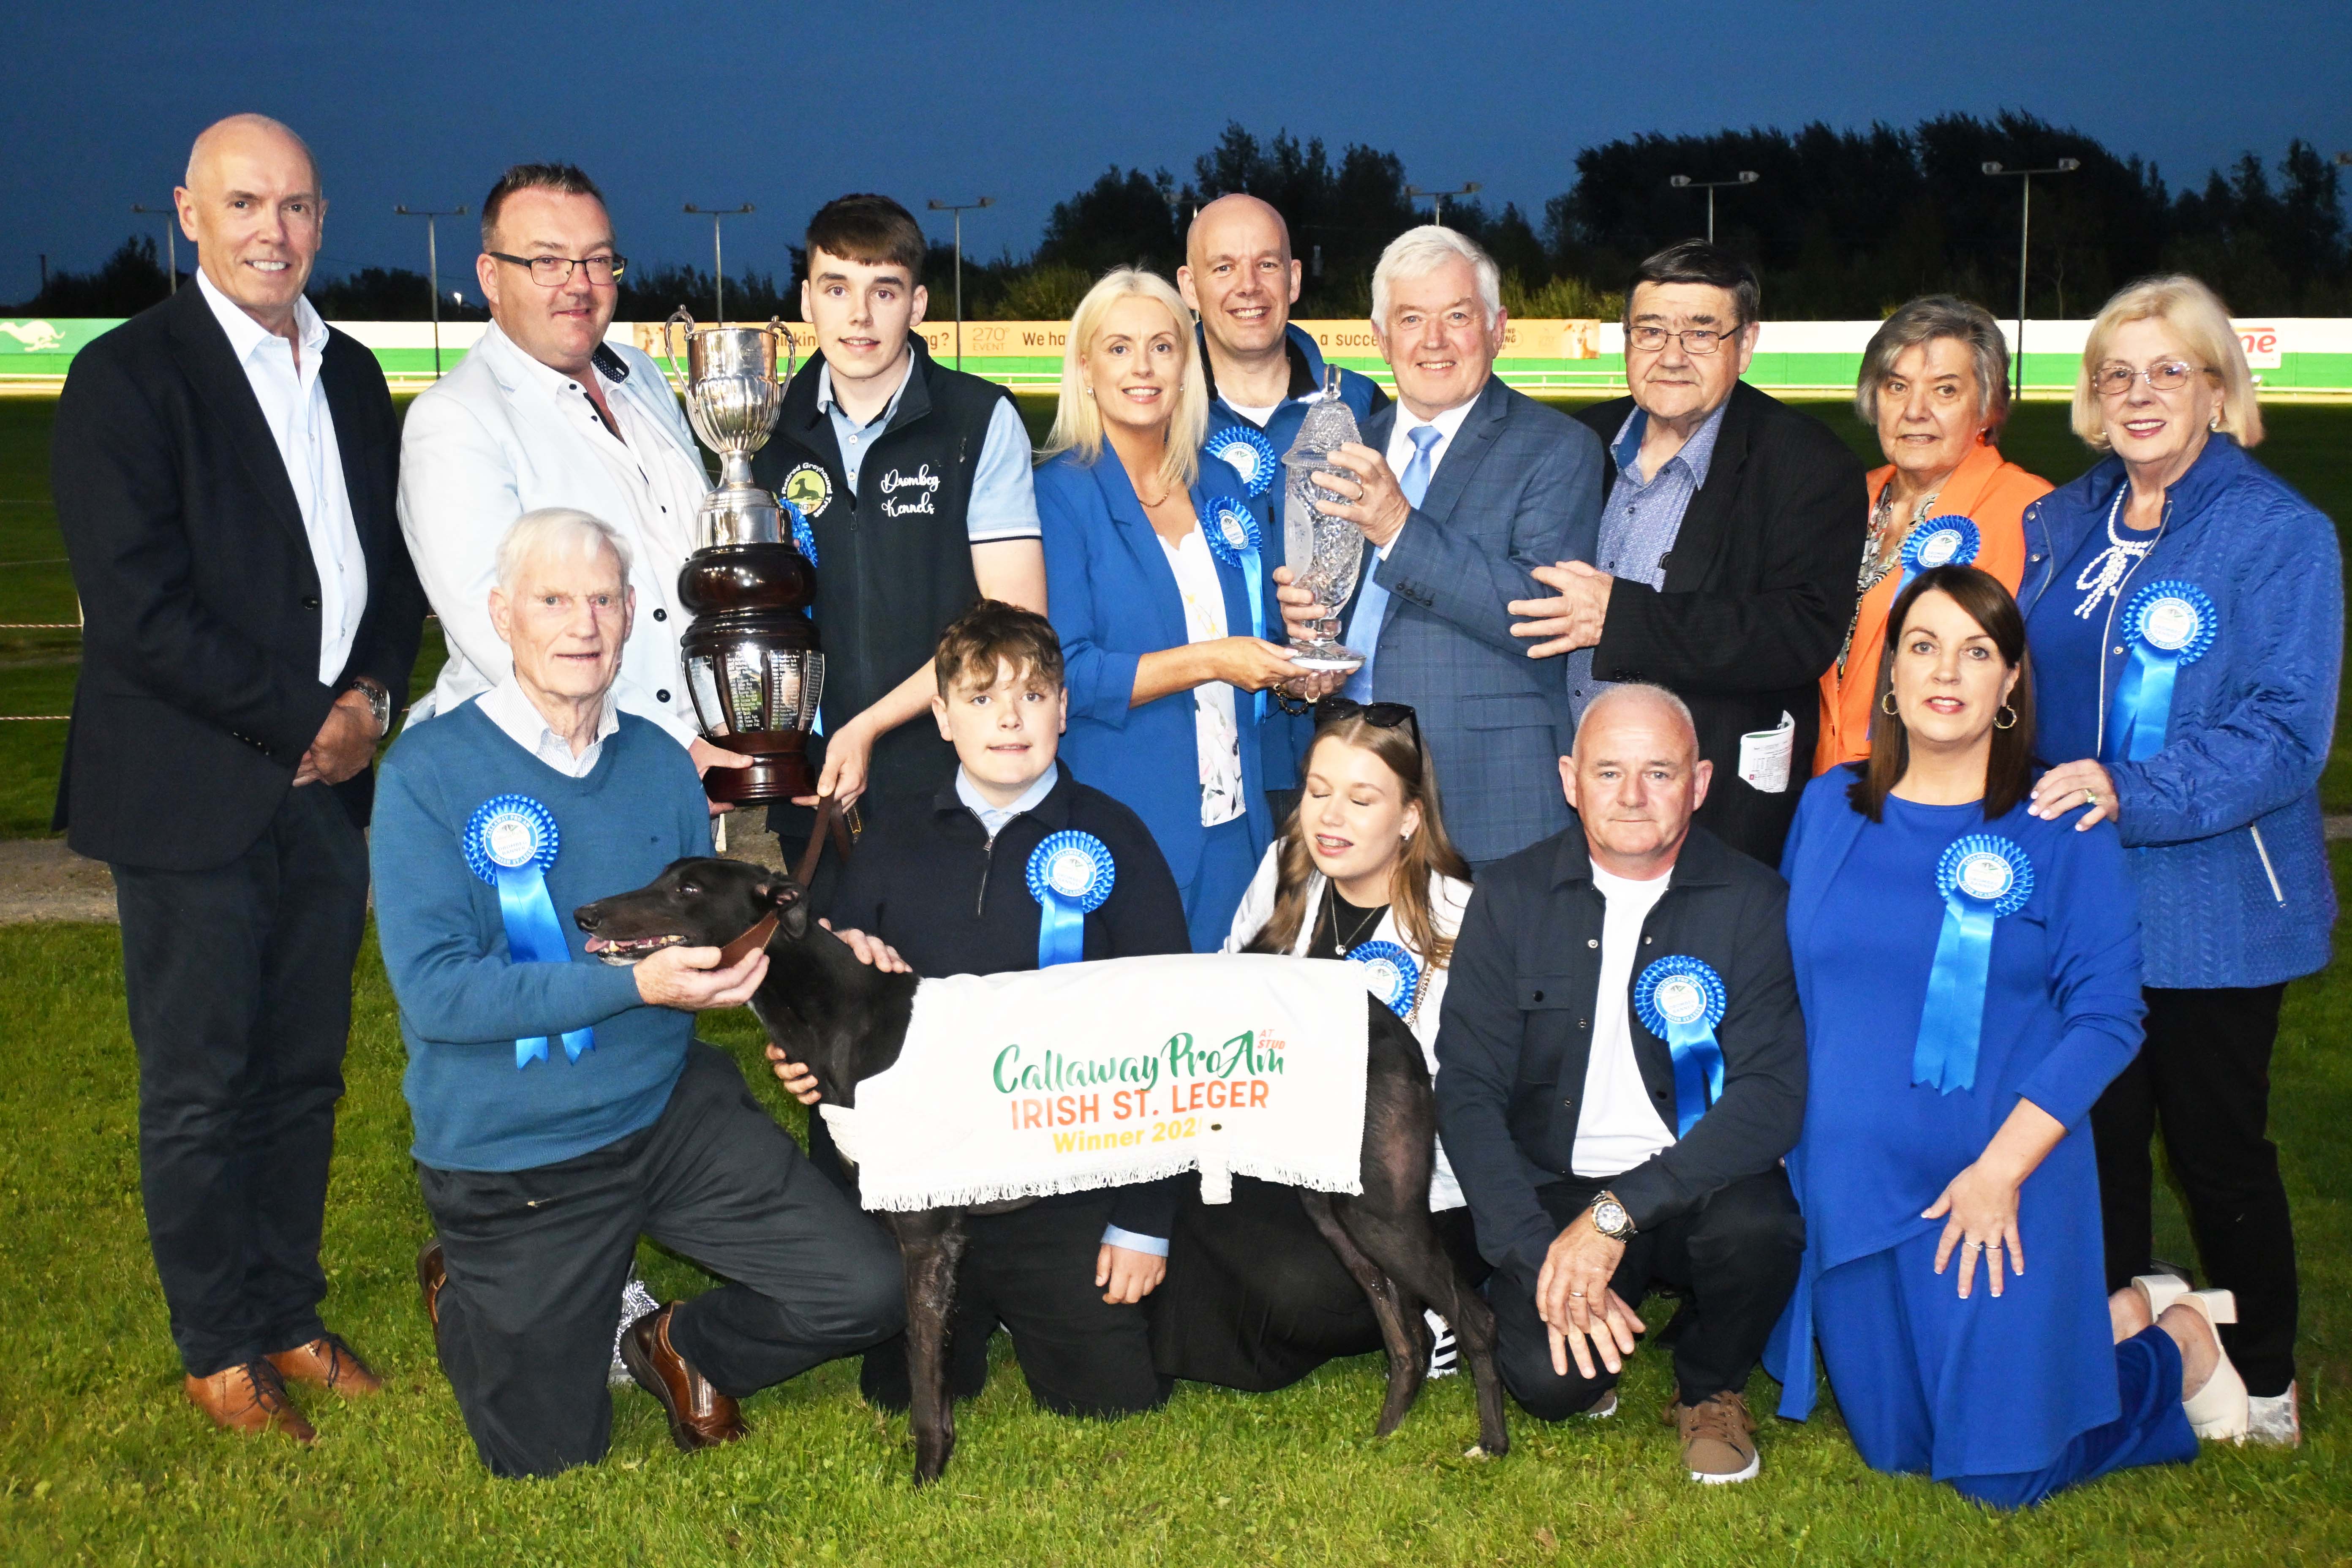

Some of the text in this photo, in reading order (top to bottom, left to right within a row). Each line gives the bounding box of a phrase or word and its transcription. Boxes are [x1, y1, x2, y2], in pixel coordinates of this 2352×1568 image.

[973, 343, 1006, 351] EVENT
[1023, 332, 1044, 346] We
[1320, 334, 1328, 346] a
[781, 464, 801, 494] Retired
[803, 462, 833, 494] Greyhound
[881, 464, 940, 493] Drombeg
[882, 492, 935, 517] Kennels
[487, 815, 508, 838] CALLAWAY
[495, 855, 510, 864] IRISH
[1258, 1040, 1285, 1049] STUD
[1259, 1029, 1274, 1038] AT
[994, 1044, 1159, 1094] Callaway
[1011, 1080, 1269, 1130] IRISH ST. LEGER
[1053, 1116, 1203, 1154] Winner 202
